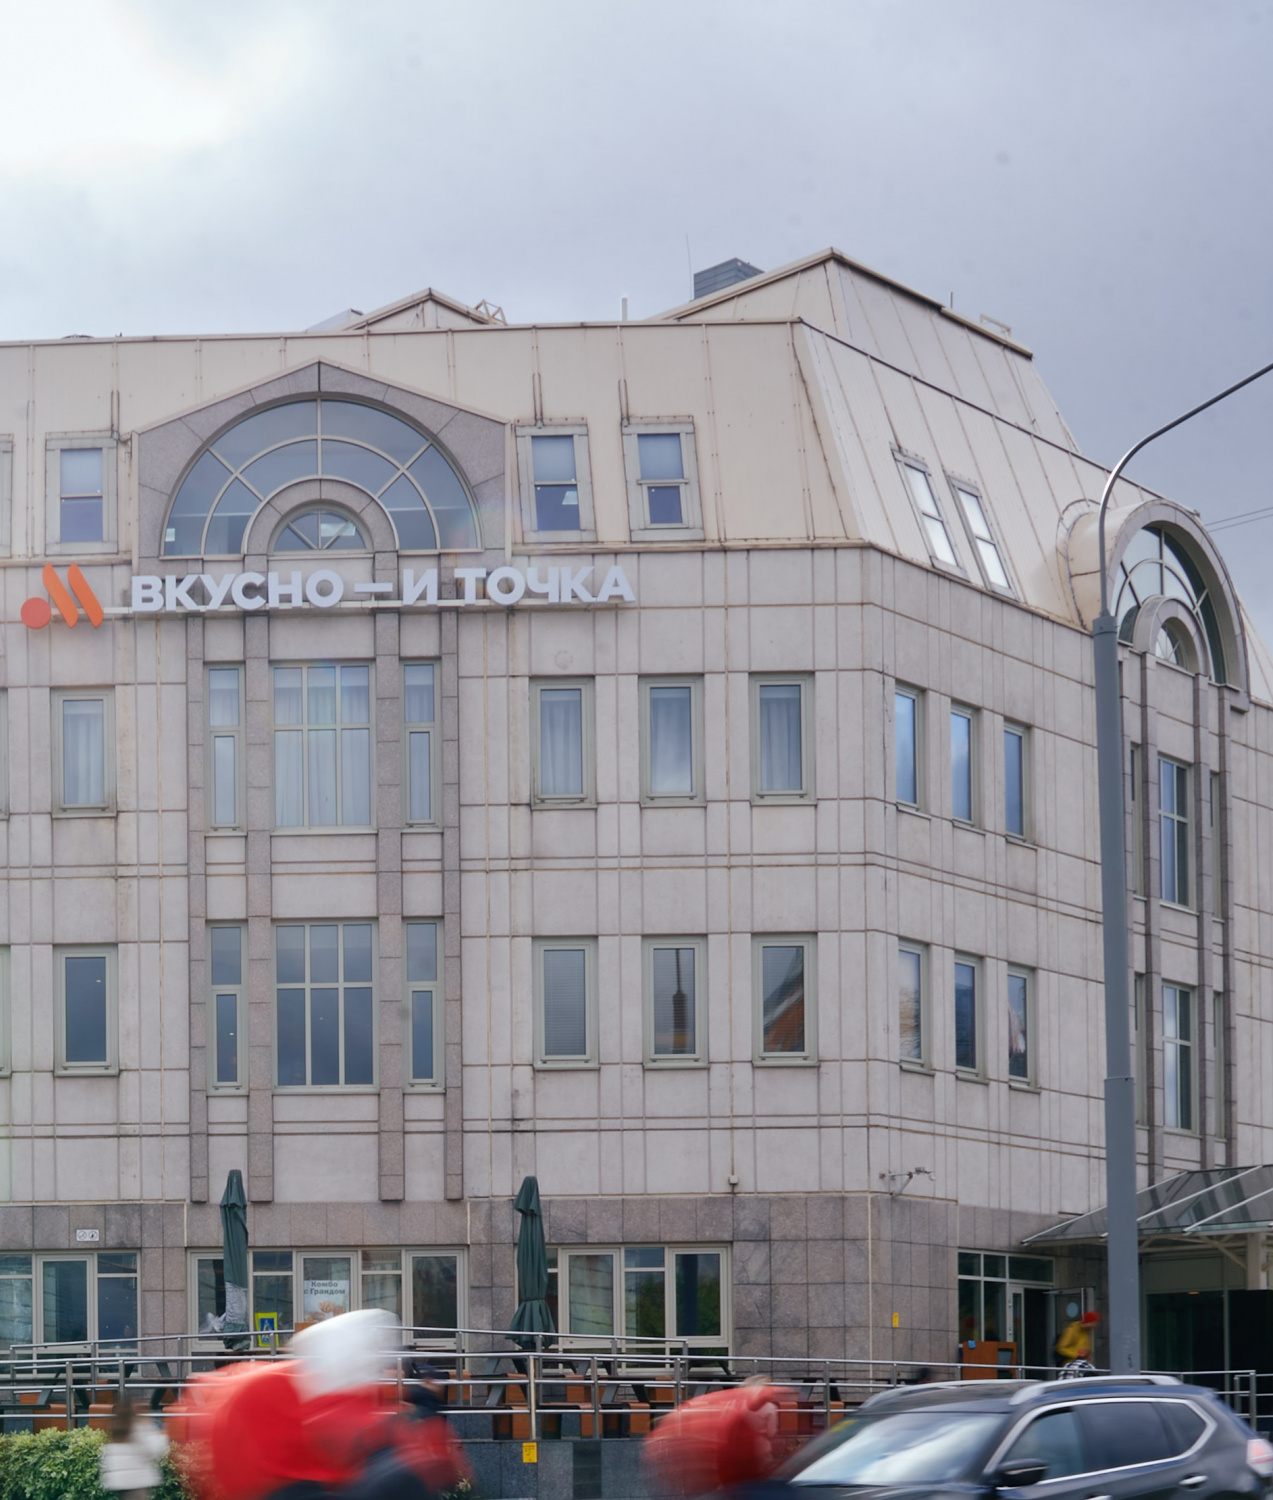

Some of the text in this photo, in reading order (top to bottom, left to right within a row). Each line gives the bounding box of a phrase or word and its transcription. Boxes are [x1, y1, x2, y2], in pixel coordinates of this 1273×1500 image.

[131, 568, 345, 612] ВКУСНО
[402, 568, 439, 606] И
[454, 565, 637, 606] ТОЧКА
[310, 1288, 346, 1296] Грандом
